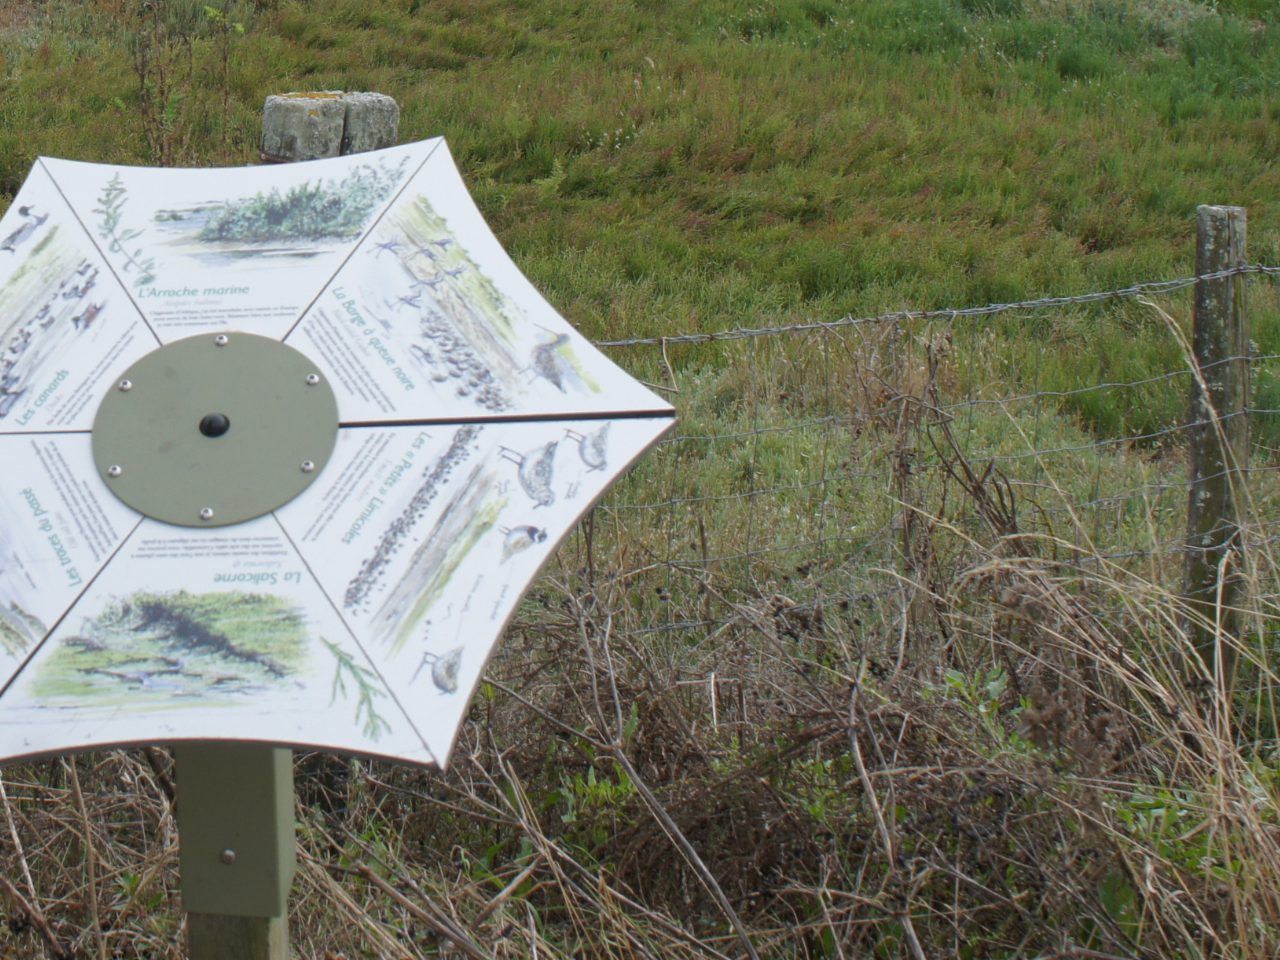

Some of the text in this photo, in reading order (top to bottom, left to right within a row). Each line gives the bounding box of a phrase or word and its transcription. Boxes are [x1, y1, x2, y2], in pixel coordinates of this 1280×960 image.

[138, 285, 250, 298] L'Arroche marine
[332, 286, 346, 300] La
[342, 299, 367, 327] Barge
[368, 337, 396, 366] queue
[392, 366, 416, 393] noire
[15, 409, 36, 426] Les
[33, 369, 70, 407] canards
[410, 431, 432, 449] Les
[18, 487, 48, 517] passé
[38, 517, 54, 533] du
[341, 495, 384, 544] Limicoles
[47, 533, 72, 566] traces
[65, 566, 83, 588] Les
[213, 570, 302, 585] La Salicorne
